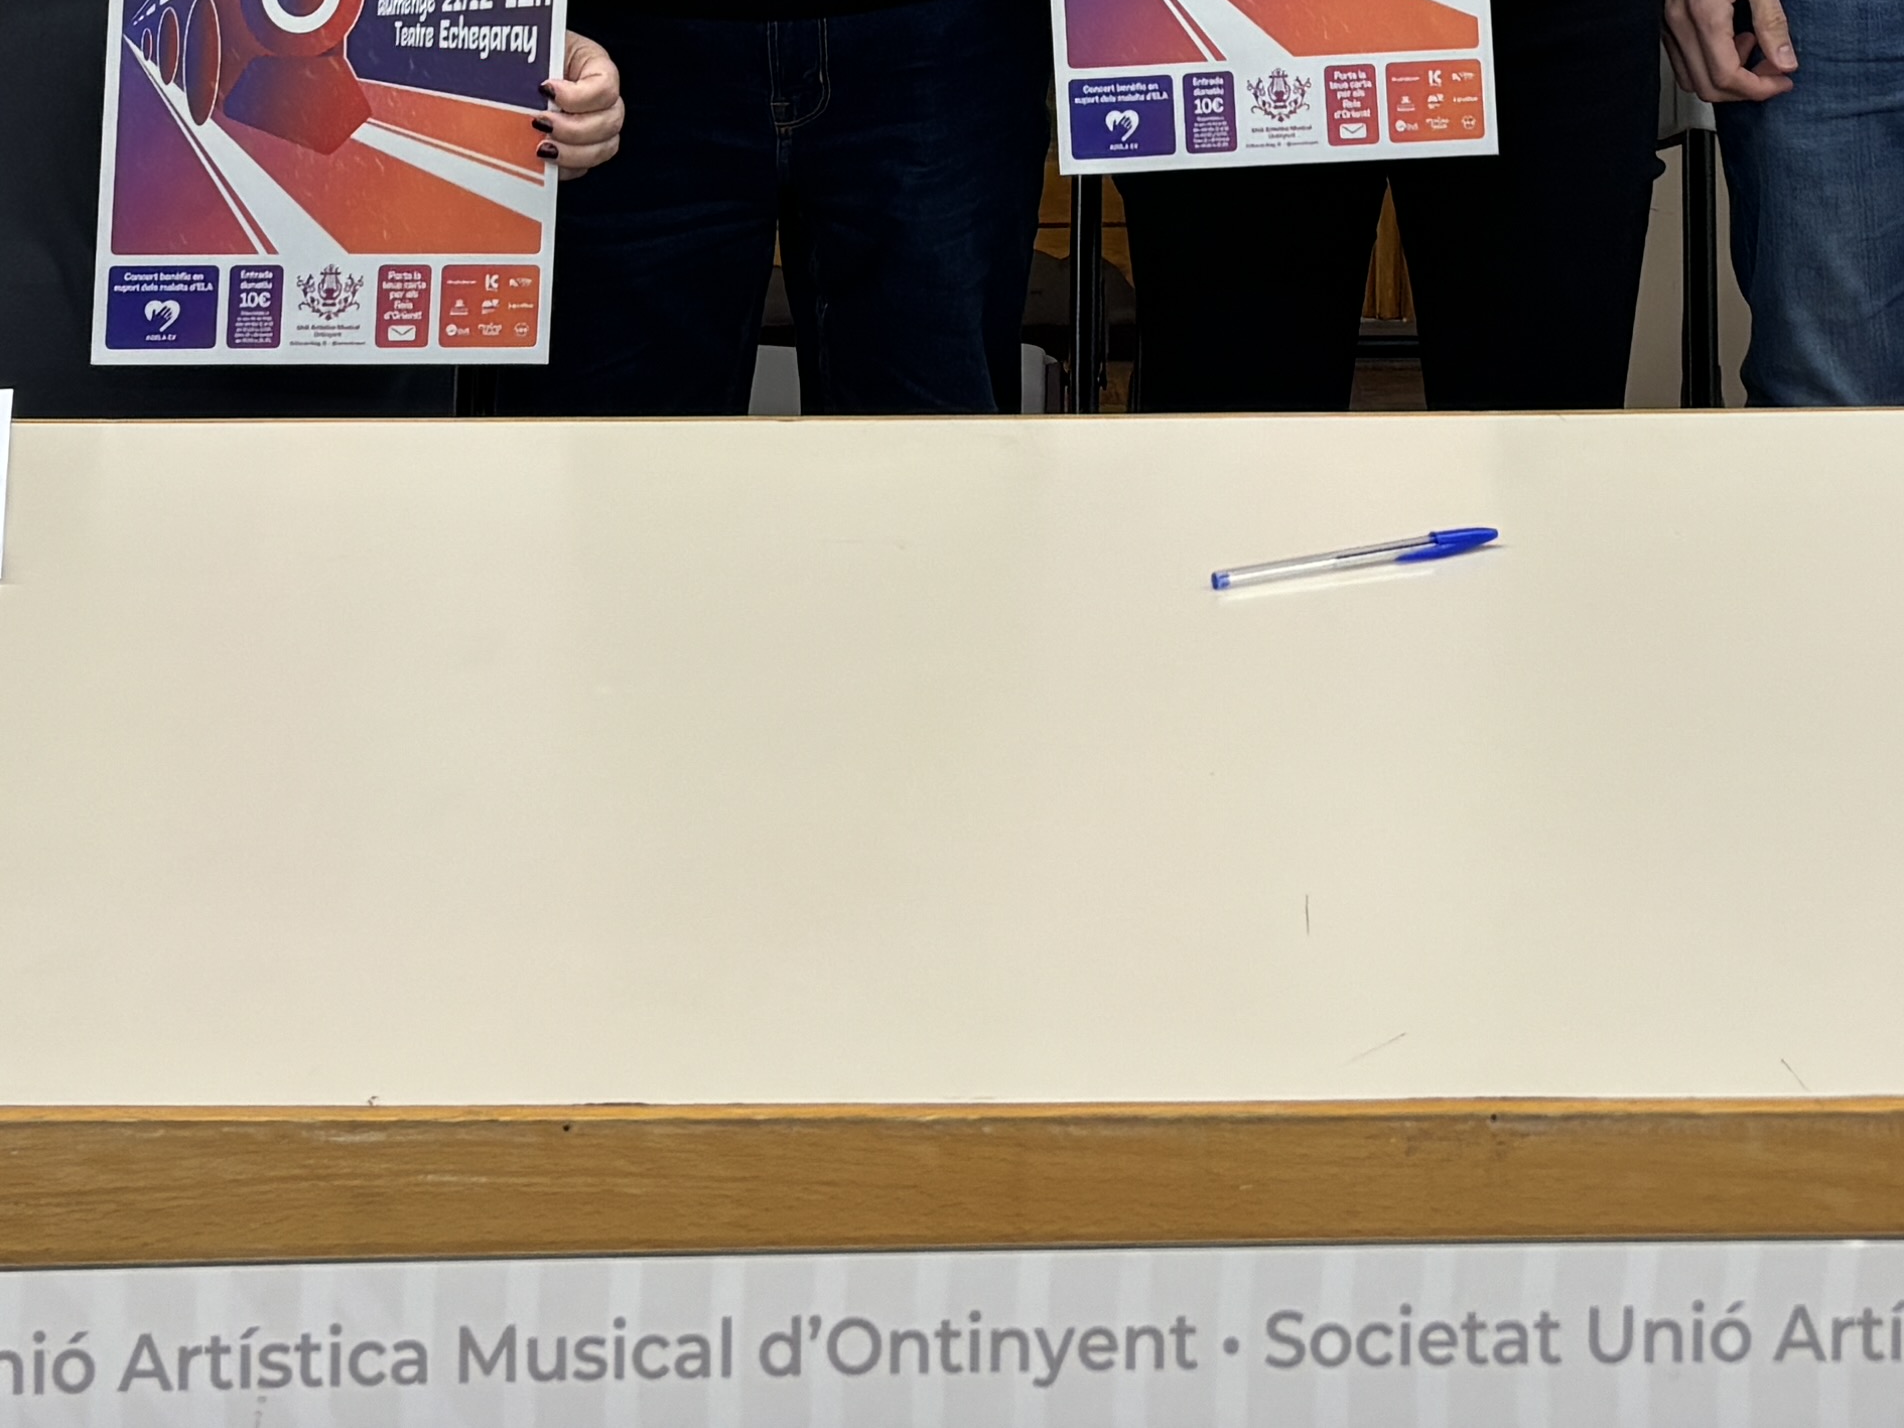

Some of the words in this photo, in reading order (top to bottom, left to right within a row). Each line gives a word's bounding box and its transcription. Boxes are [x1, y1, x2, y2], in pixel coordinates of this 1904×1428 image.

[394, 21, 437, 49] Teatre
[439, 22, 538, 63] Echegaray
[116, 1322, 431, 1392] Artística
[458, 1316, 733, 1385] Musical
[1264, 1303, 1563, 1370] Societat
[1588, 1299, 1752, 1365] Unió
